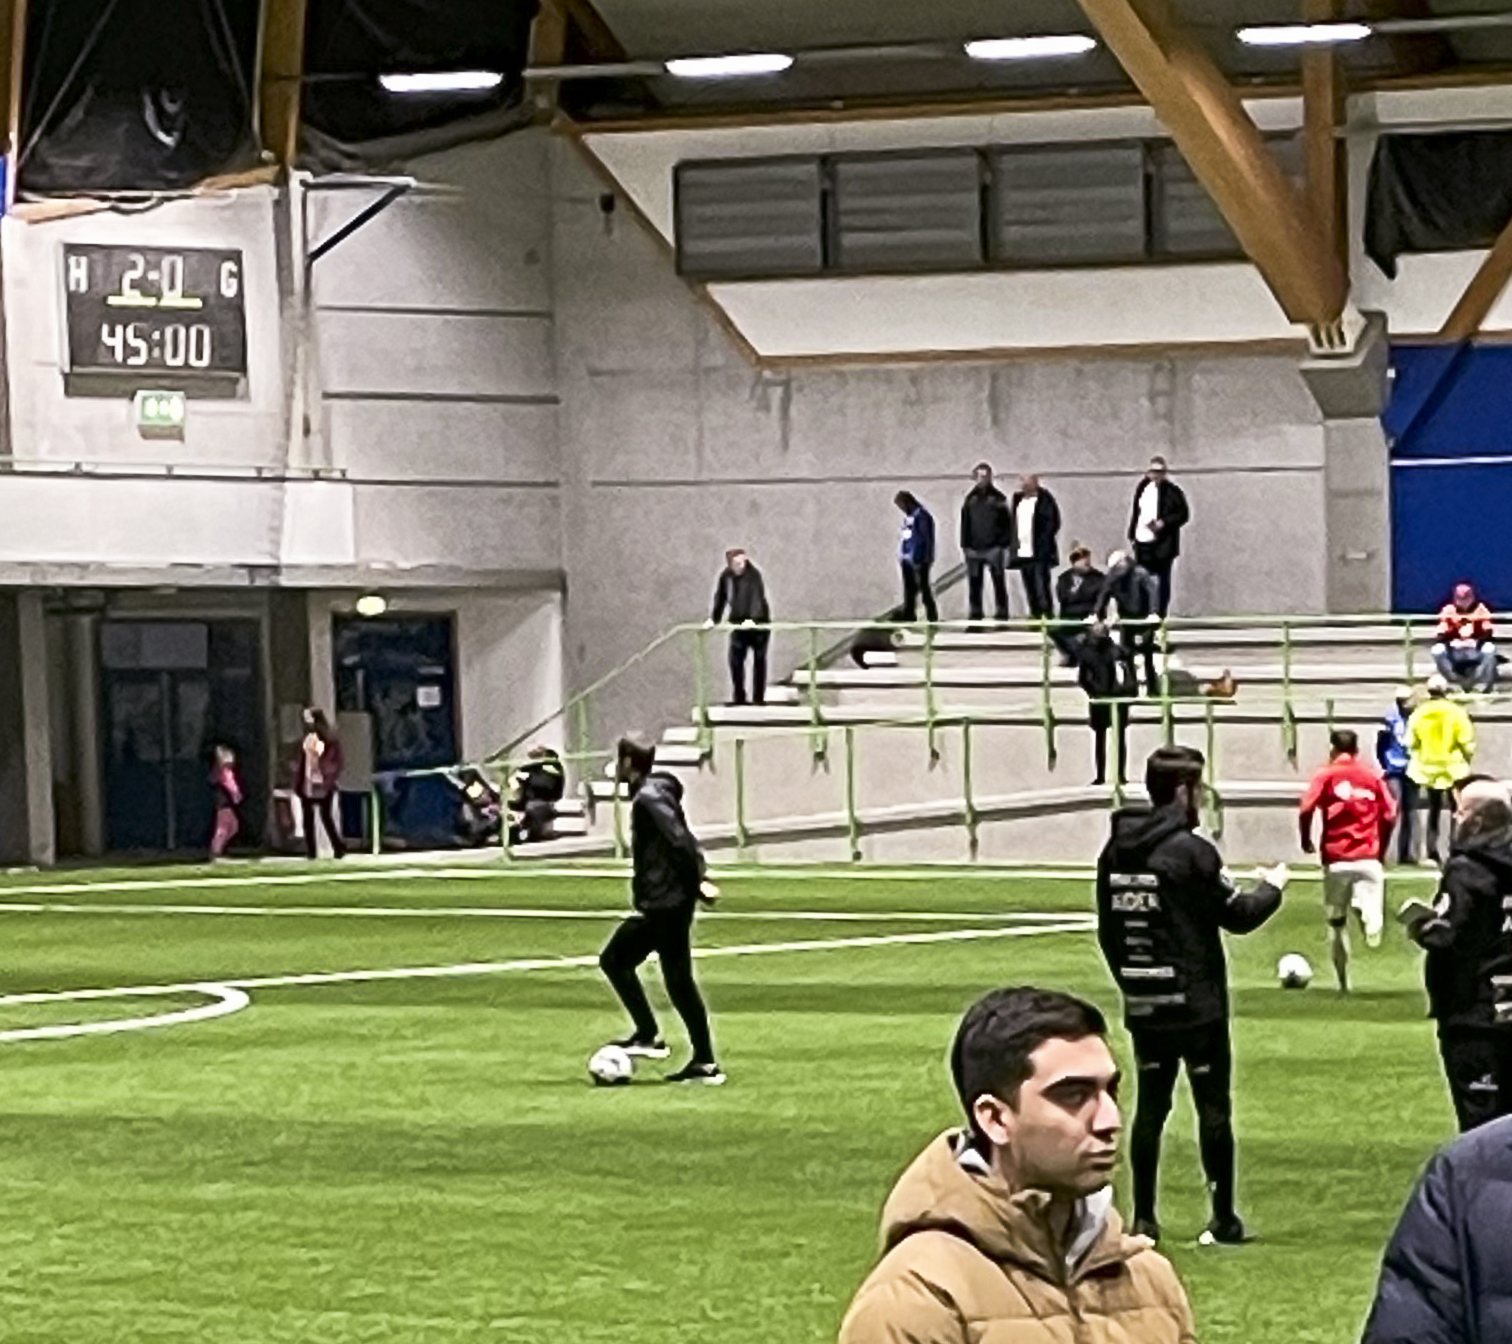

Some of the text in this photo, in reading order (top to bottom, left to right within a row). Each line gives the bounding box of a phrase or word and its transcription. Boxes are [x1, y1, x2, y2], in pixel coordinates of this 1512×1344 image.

[68, 253, 239, 299] H 2-0 G
[101, 322, 211, 367] 45:00
